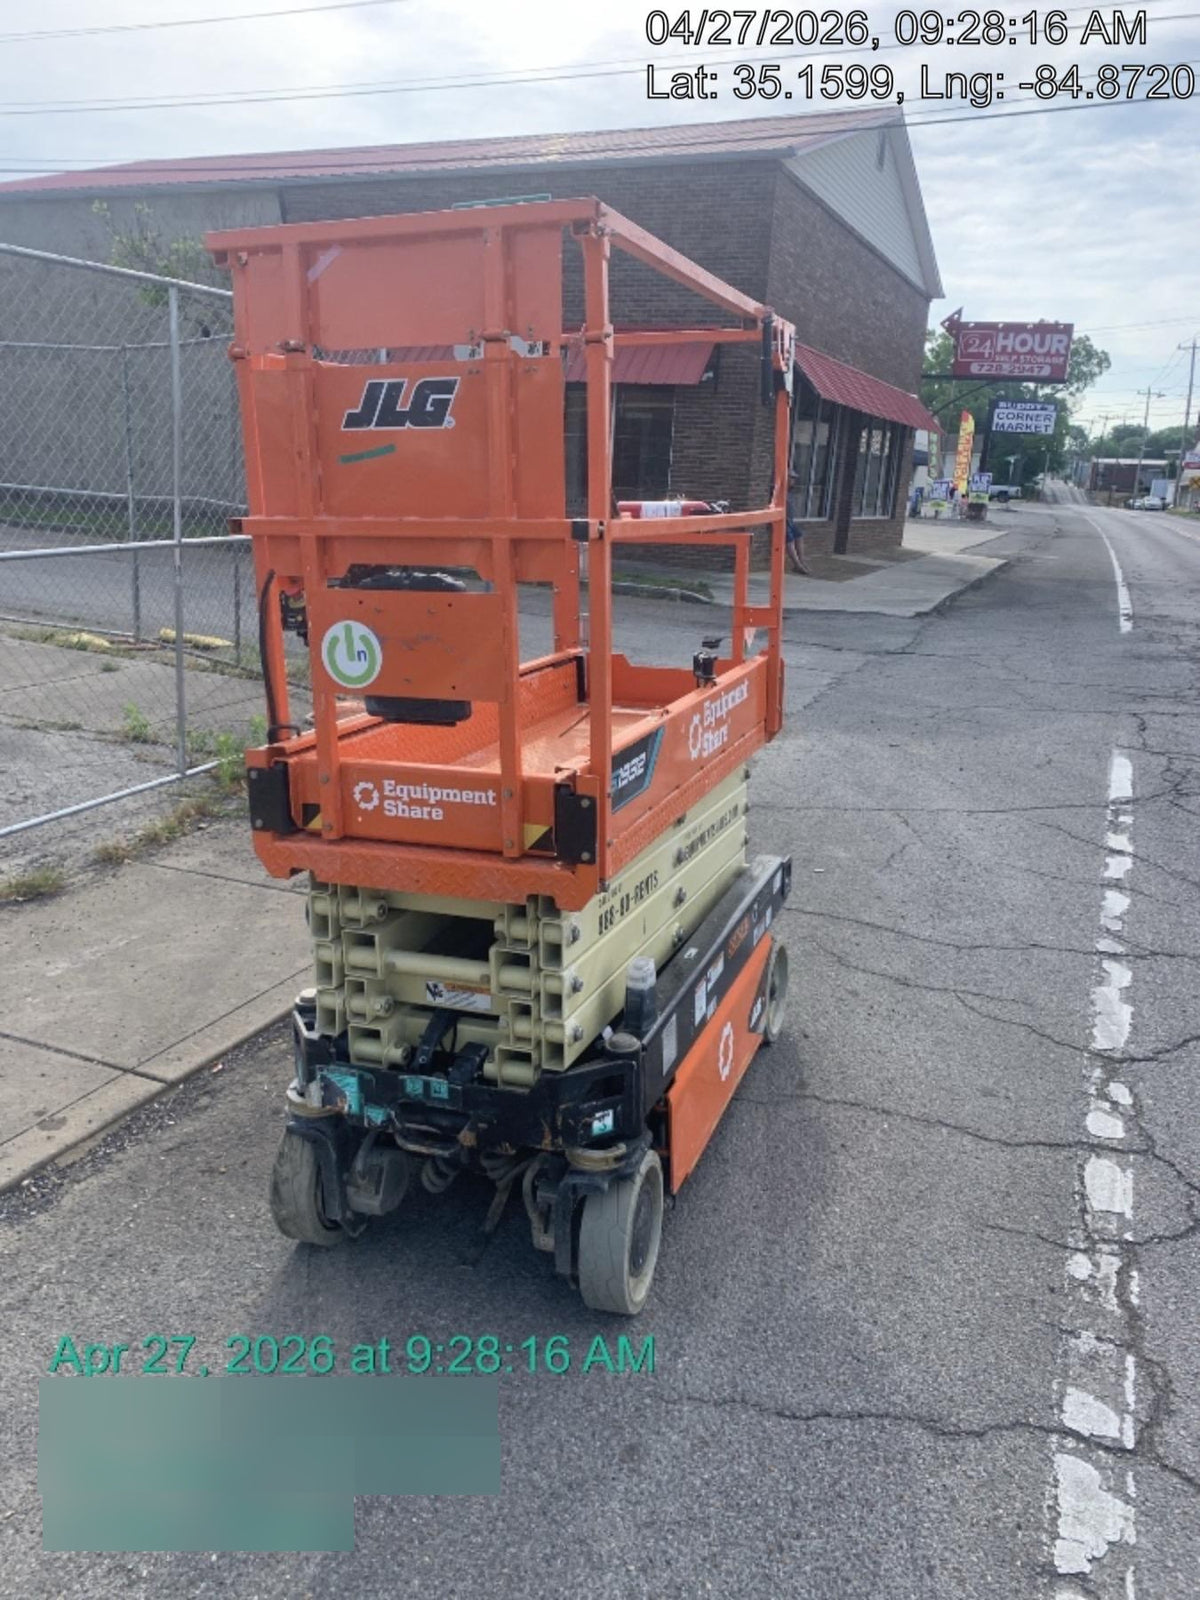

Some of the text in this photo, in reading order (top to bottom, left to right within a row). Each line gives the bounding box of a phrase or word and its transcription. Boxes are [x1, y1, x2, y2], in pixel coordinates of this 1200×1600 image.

[964, 332, 1069, 358] 24 HOUR
[341, 376, 460, 431] JLG
[995, 422, 1051, 433] MARKET
[996, 411, 1053, 422] CORNER
[383, 779, 497, 806] Equipment
[384, 800, 444, 820] Share
